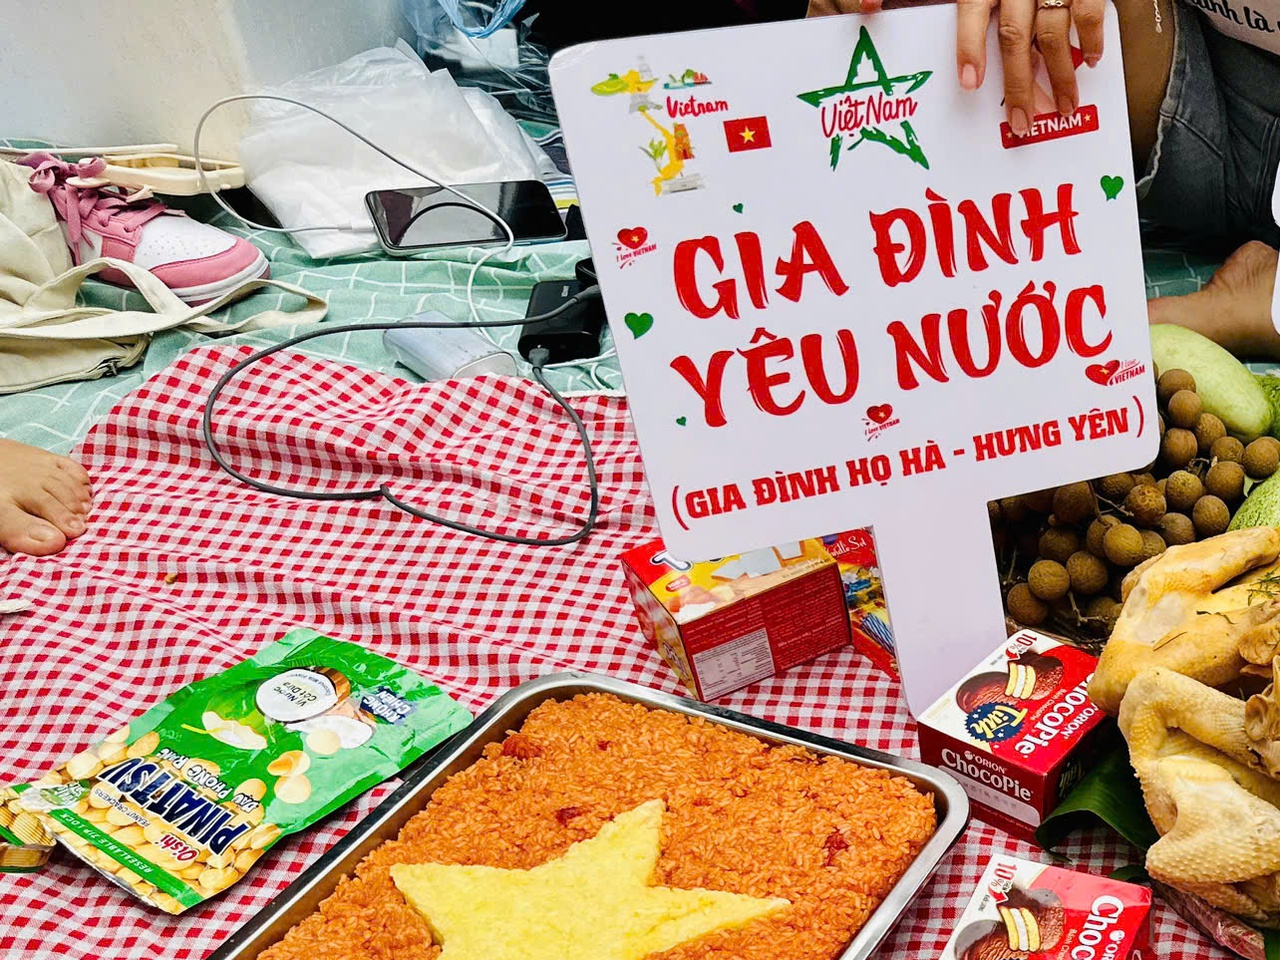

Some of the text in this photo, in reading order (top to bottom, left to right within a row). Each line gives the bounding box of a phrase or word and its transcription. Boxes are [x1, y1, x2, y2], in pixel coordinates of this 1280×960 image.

[1245, 8, 1275, 33] là
[666, 95, 729, 119] Vietnam
[821, 91, 918, 138] Việt Nam
[1018, 112, 1083, 139] IETNAM
[672, 183, 1083, 320] GIA ĐÌNH
[669, 281, 1114, 428] YÊU NƯỚC
[1114, 364, 1145, 385] VIETNAM
[752, 470, 840, 506] ĐÌNH
[845, 454, 892, 487] HỌ
[898, 439, 947, 477] HÀ
[972, 419, 1062, 462] HƯNG
[1061, 703, 1099, 740] ORION
[941, 748, 1033, 802] ChocoPie
[974, 754, 1007, 774] ORION
[93, 788, 129, 814] CRACKERS
[95, 756, 253, 856] PINATTSU
[127, 811, 150, 829] PEANUT
[60, 813, 154, 874] RESEALABLE ZIP LOCK
[154, 834, 200, 862] Oishi
